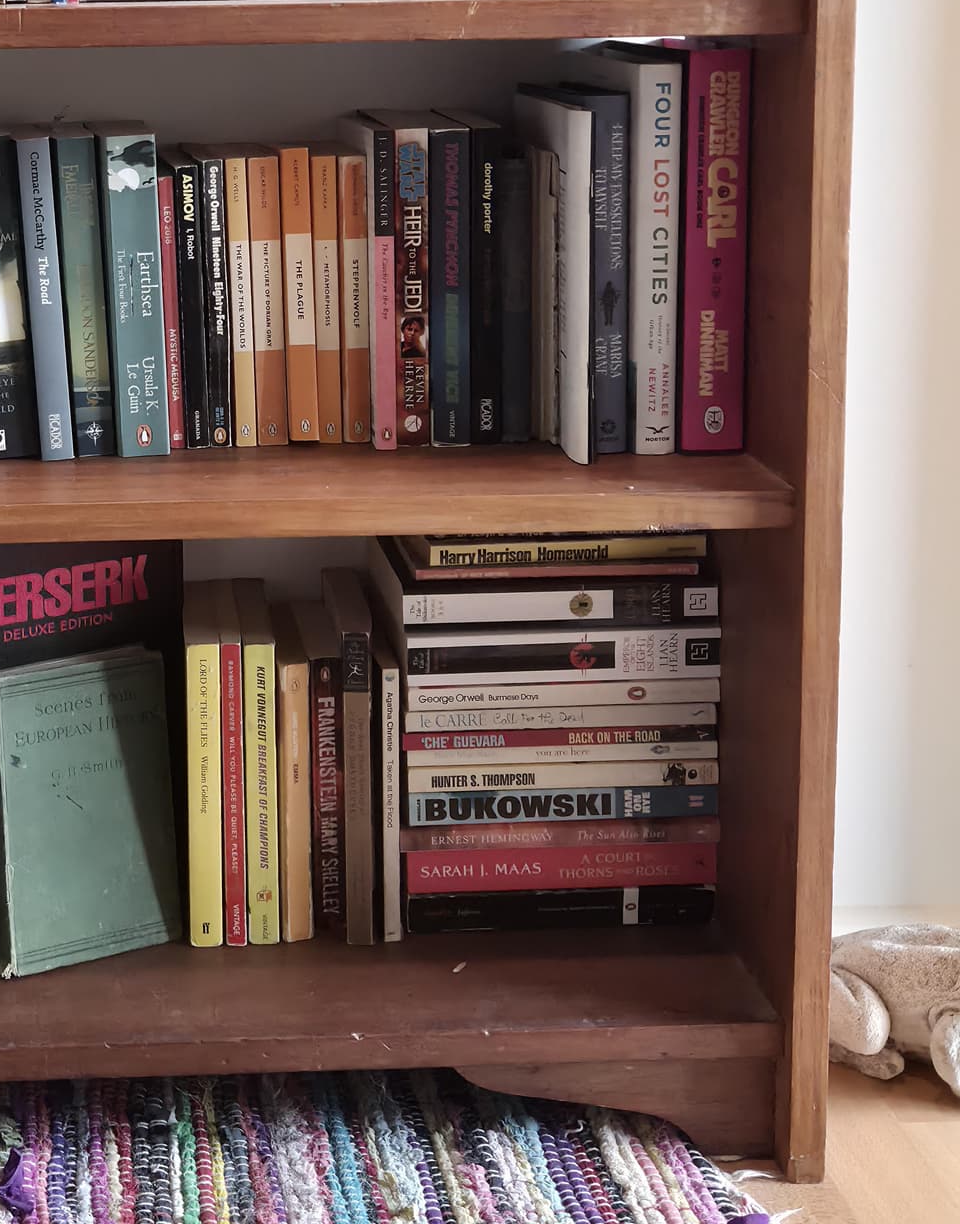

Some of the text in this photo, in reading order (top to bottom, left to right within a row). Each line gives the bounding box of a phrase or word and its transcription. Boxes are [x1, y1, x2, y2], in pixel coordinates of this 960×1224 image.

[181, 174, 195, 222] ASIMOV
[651, 82, 672, 306] FOUR LOST CITIES
[707, 158, 737, 249] CARL
[403, 206, 422, 248] HEIR
[137, 252, 152, 318] Earthsea
[352, 259, 360, 330] STEPPENWOLF
[405, 276, 422, 313] JEDI
[405, 360, 414, 410] HEARNE
[439, 544, 609, 565] Harry Harrison Homeworld
[3, 612, 113, 643] DELUXE EDITION
[257, 691, 267, 742] VONNEGUT
[568, 730, 661, 744] BACK ON THE ROAD
[431, 772, 536, 788] HUNTER S. THOMPSON
[425, 793, 612, 821] BUKOWSKI
[421, 864, 474, 878] SARAH
[495, 861, 542, 875] MAAS
